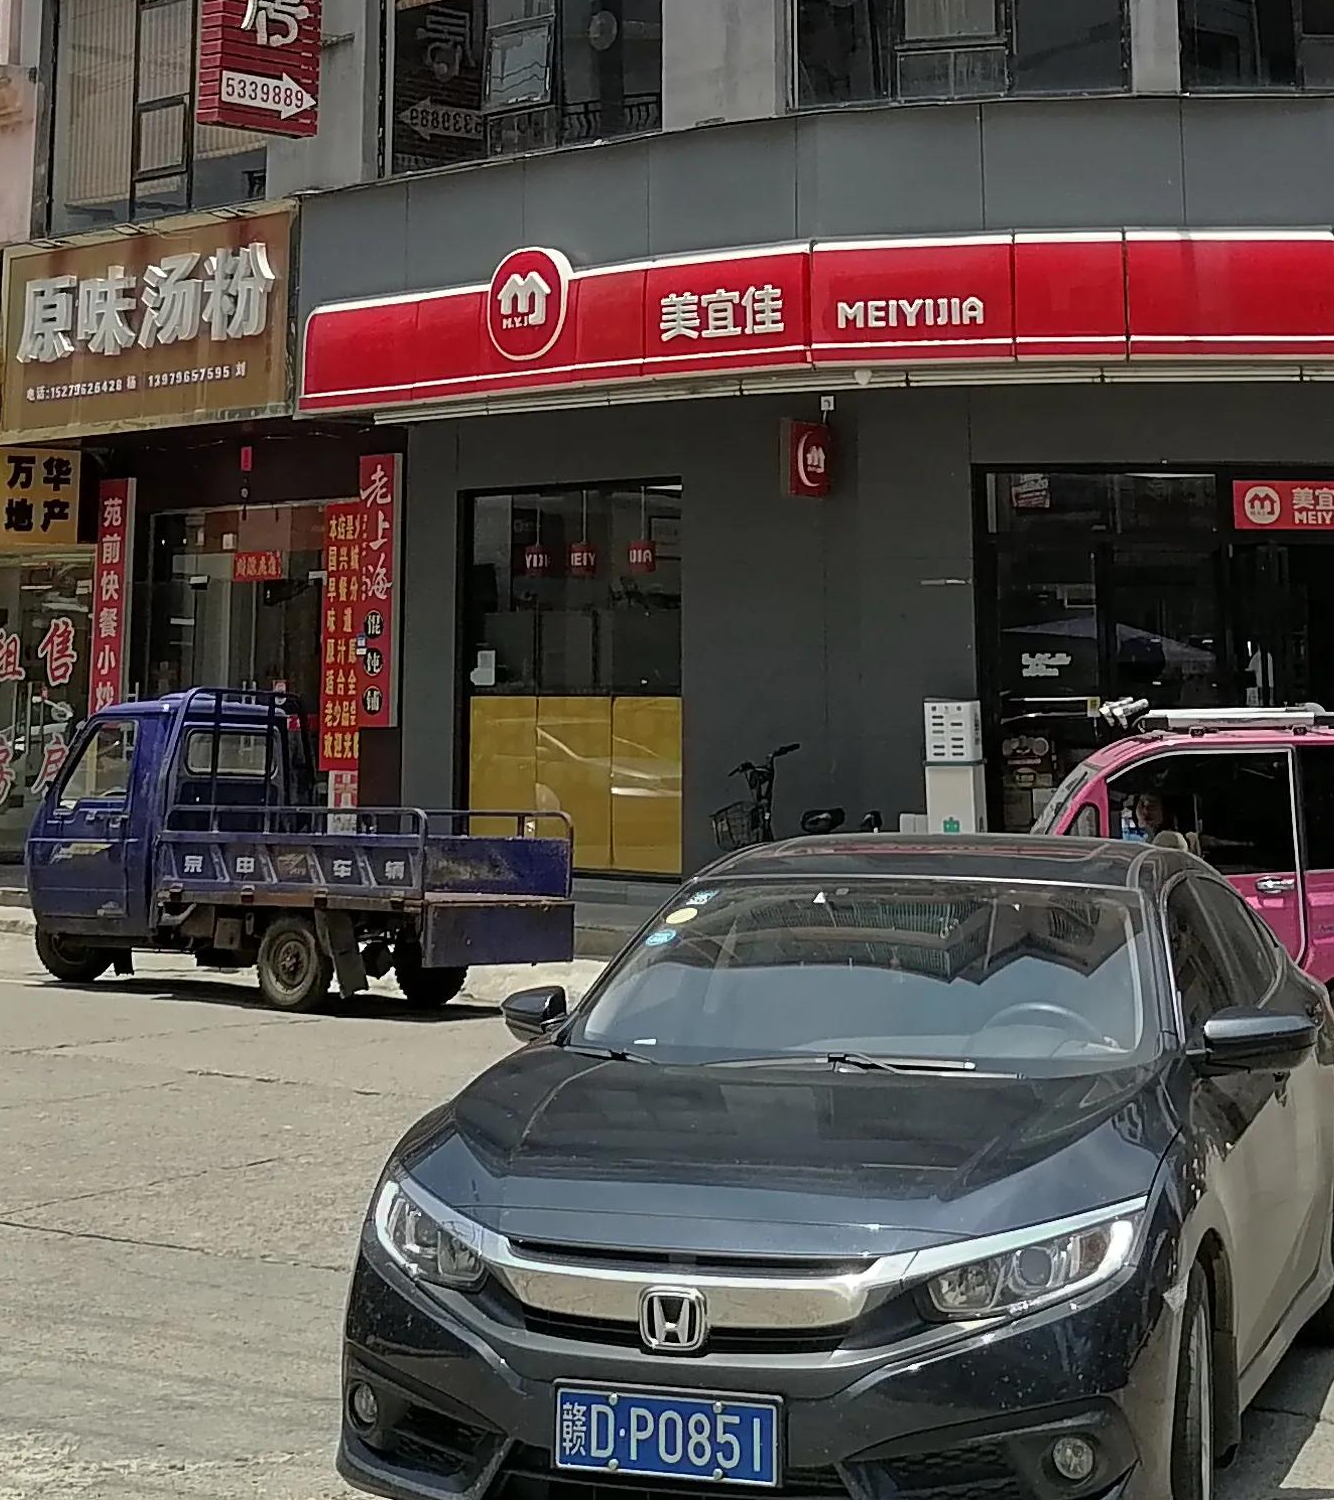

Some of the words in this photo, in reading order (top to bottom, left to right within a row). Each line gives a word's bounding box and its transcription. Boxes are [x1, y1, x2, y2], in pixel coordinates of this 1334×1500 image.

[225, 76, 305, 111] 5339889
[16, 241, 276, 364] 原味汤粉
[659, 285, 785, 342] 美宜佳
[836, 296, 986, 329] MEIYIJIA
[7, 454, 73, 492] 万华
[4, 498, 71, 533] 地产
